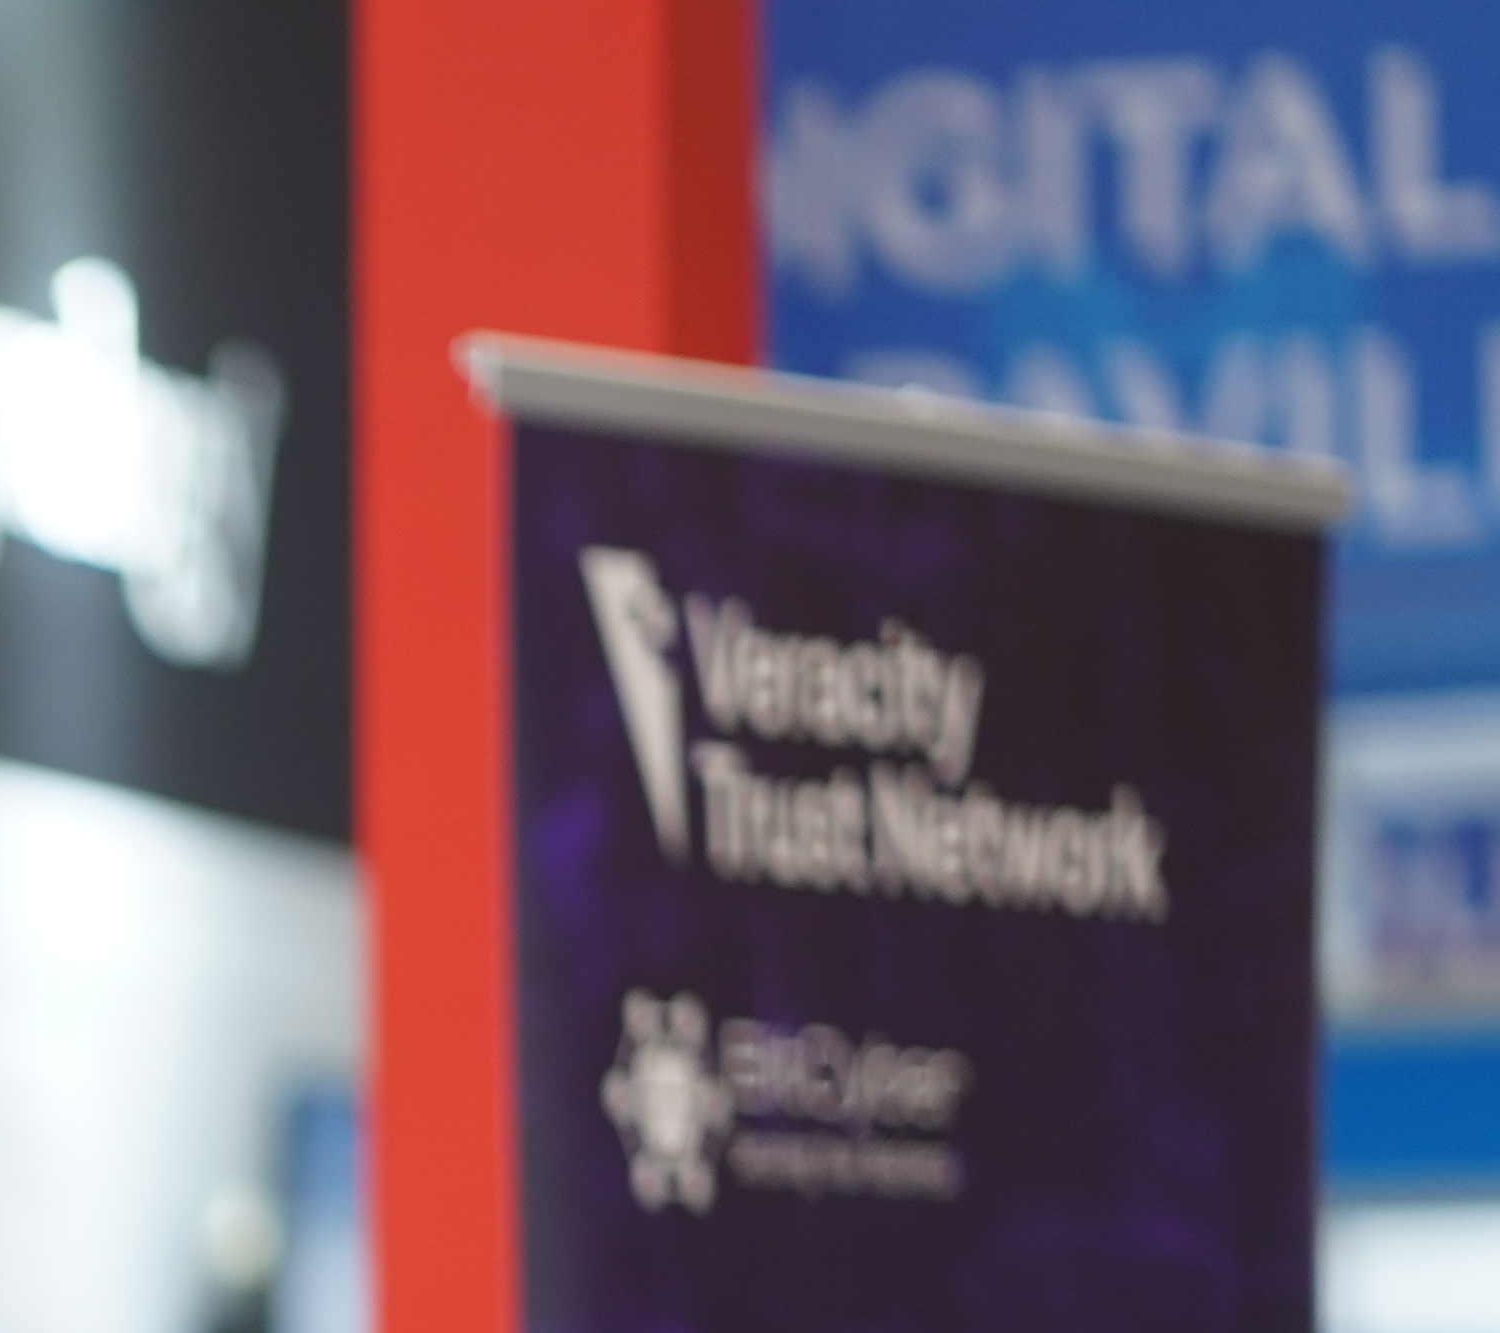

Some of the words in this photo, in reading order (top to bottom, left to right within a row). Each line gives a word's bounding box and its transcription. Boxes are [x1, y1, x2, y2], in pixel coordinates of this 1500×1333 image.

[686, 594, 984, 782] Veracity
[693, 740, 870, 896] Trust
[872, 760, 1170, 924] Network
